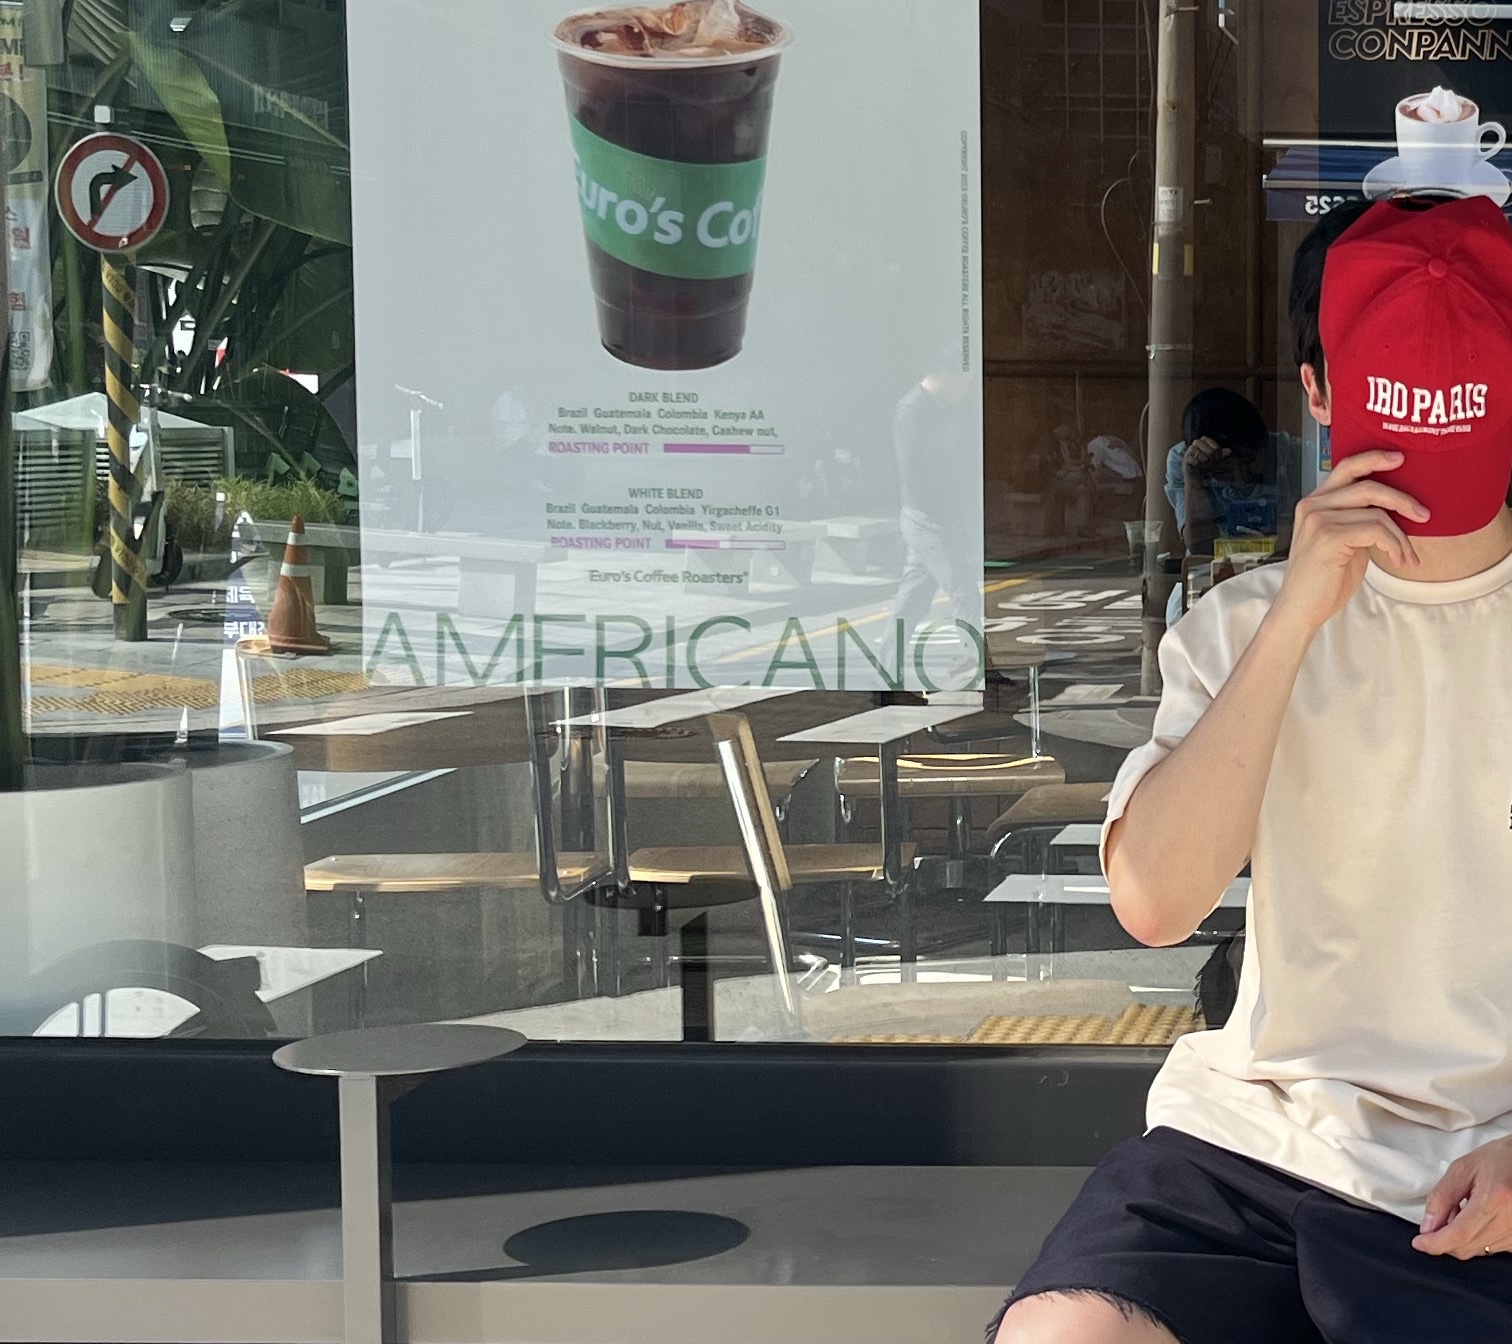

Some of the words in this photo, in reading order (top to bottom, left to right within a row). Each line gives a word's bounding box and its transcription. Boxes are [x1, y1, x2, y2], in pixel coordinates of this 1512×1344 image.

[629, 392, 659, 404] DARK
[662, 392, 699, 404] BLEND
[1411, 383, 1488, 425] PARIS
[558, 408, 588, 419] Brazil
[593, 408, 652, 420] Guatemala
[657, 409, 709, 420] Colombia
[714, 409, 747, 422] Kenya
[750, 410, 765, 420] AA
[624, 425, 649, 436] Dark
[712, 425, 754, 437] Cashew
[548, 441, 610, 454] ROASTING
[613, 442, 650, 454] POINT
[628, 488, 665, 500] WHITE
[667, 488, 704, 500] BLEND
[546, 503, 576, 514] Brazil
[581, 503, 639, 515] Guatemala
[645, 504, 696, 516] Colombia
[551, 537, 611, 549] ROASTING
[614, 537, 652, 549] POINT
[589, 570, 631, 583] Euro's
[634, 570, 679, 583] Coffee
